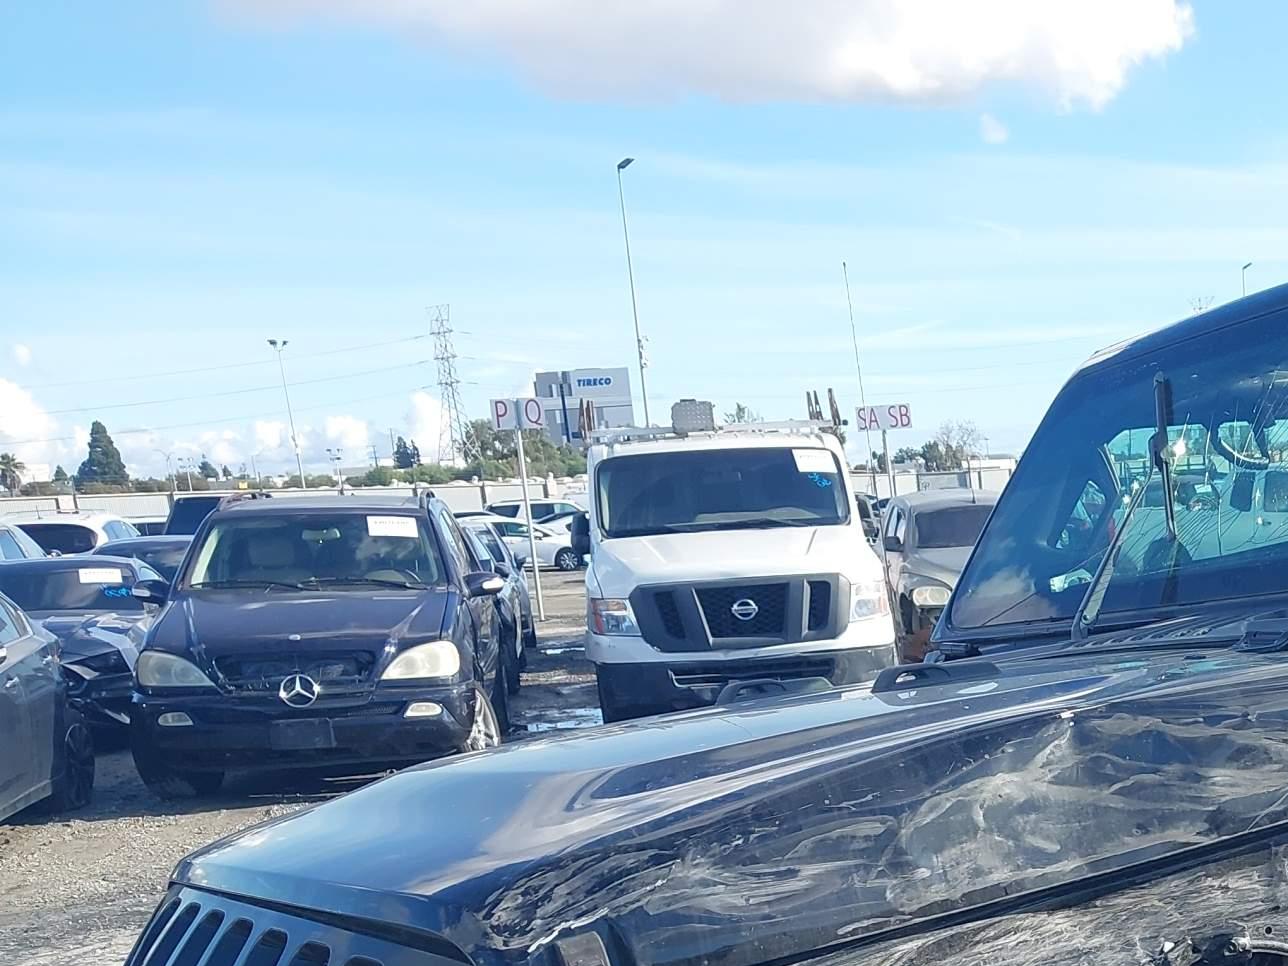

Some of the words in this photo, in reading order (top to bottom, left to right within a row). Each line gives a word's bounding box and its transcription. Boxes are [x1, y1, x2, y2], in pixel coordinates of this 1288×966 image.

[576, 377, 612, 388] TIRECO
[494, 400, 508, 429] P
[524, 399, 543, 427] Q
[857, 407, 881, 431] SA
[887, 404, 911, 428] SB
